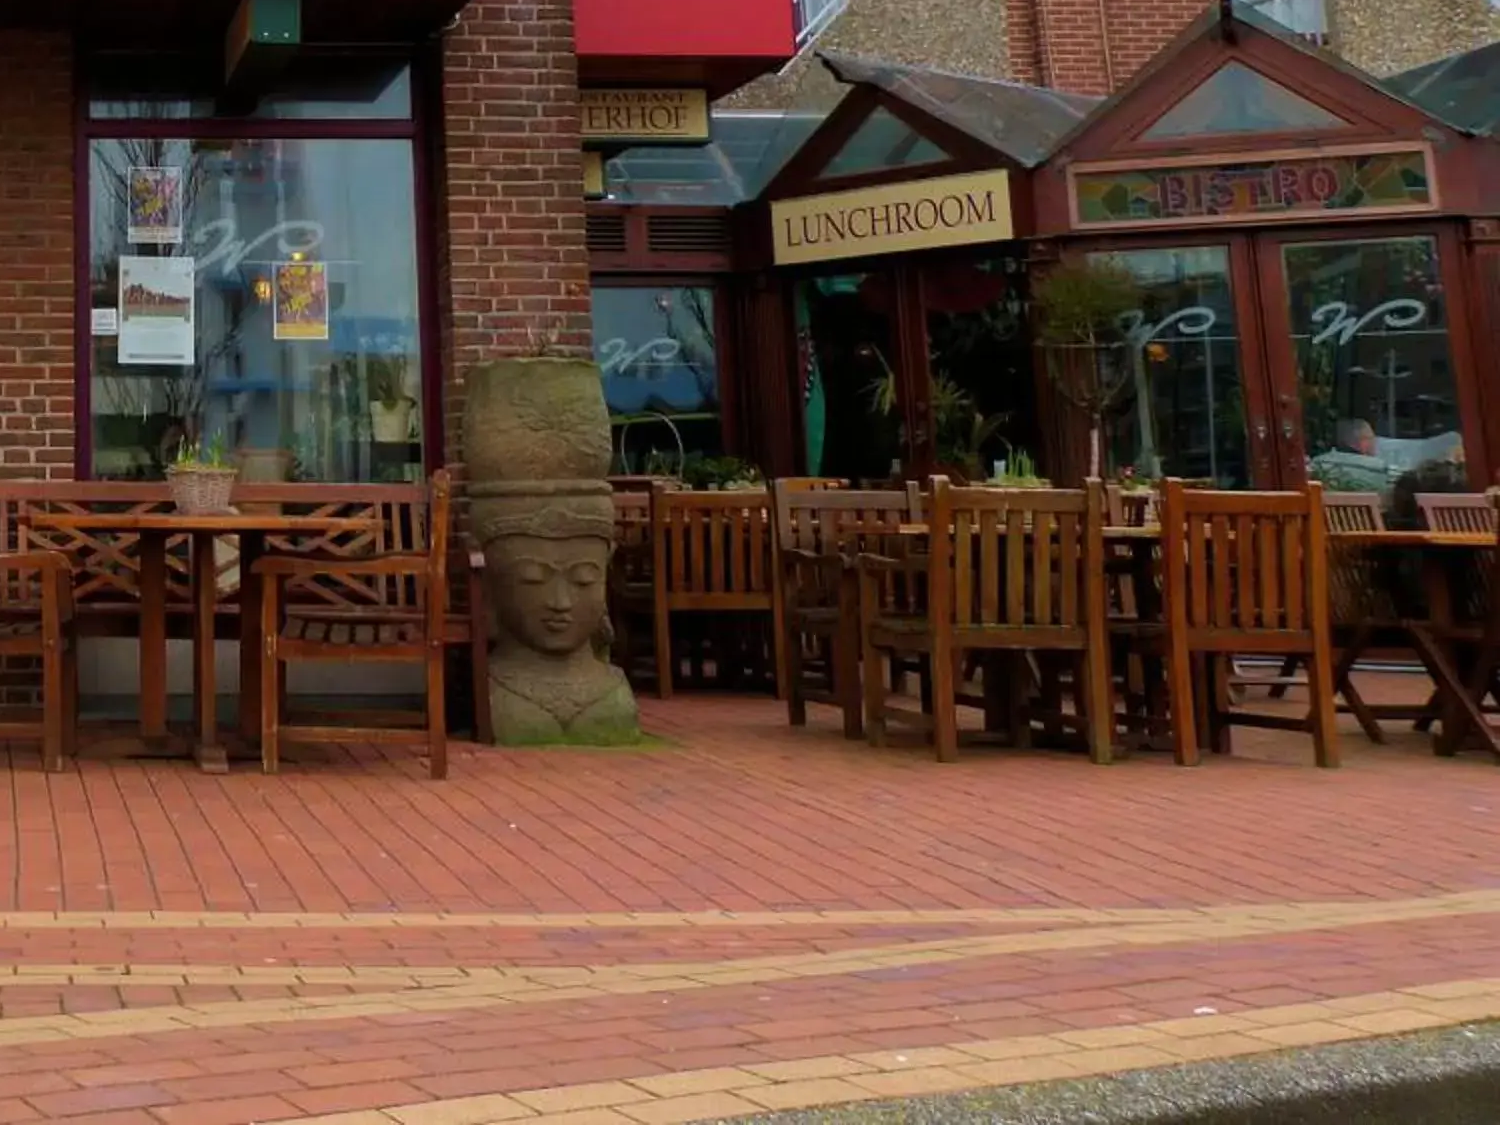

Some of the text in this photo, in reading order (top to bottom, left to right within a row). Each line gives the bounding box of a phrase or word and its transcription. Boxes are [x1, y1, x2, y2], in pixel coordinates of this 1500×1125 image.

[588, 105, 690, 130] ERHOF
[784, 190, 997, 248] LUNCHROOM
[1157, 162, 1339, 219] BISTRO
